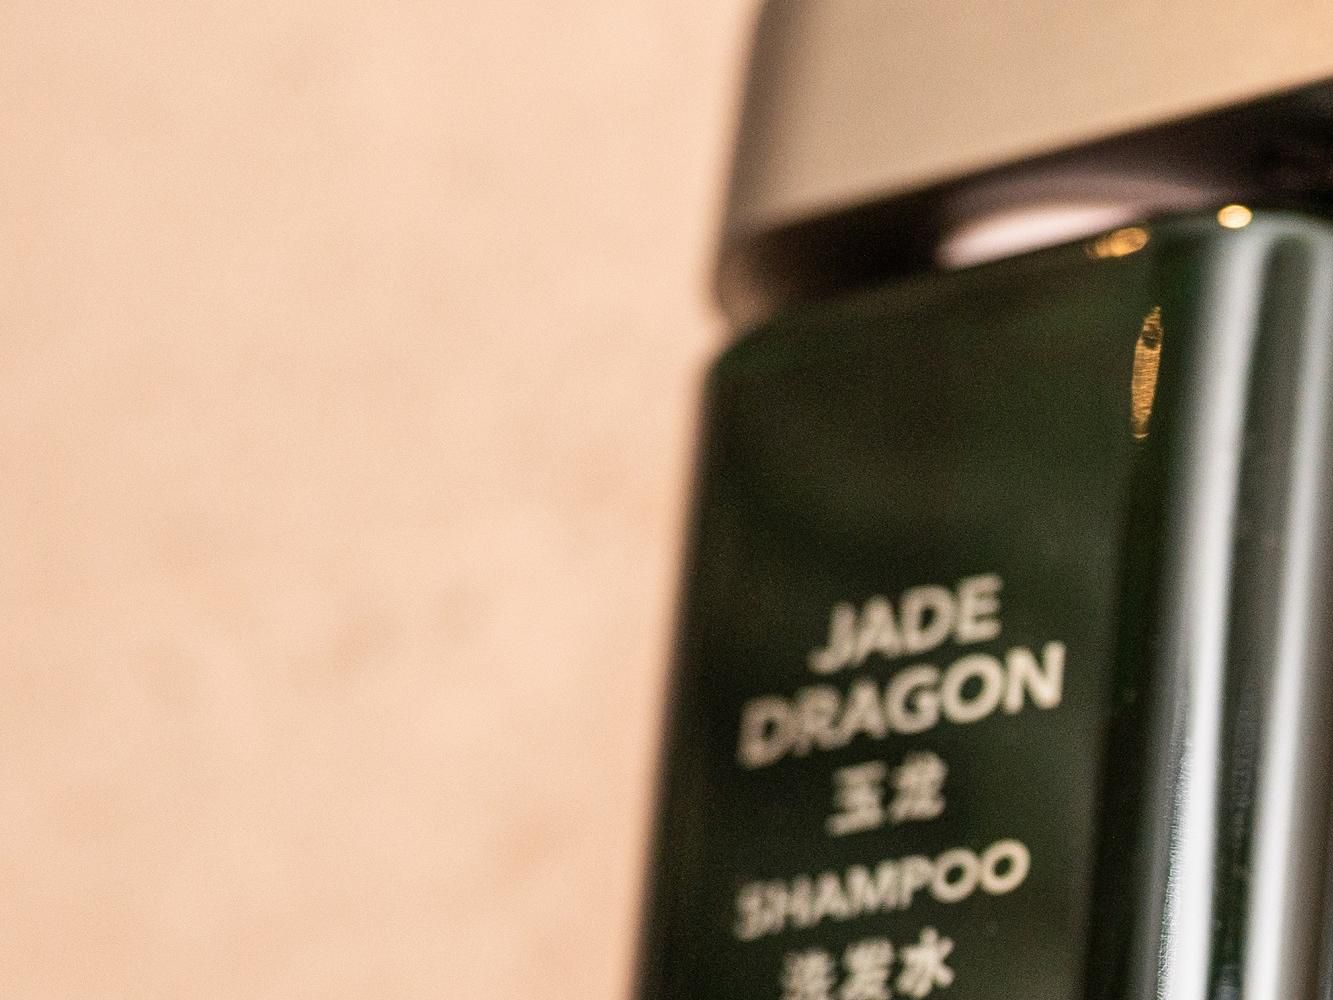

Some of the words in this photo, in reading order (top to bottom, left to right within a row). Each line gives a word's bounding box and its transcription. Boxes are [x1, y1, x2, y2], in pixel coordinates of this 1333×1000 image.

[809, 574, 1002, 674] JADE
[738, 641, 1066, 769] DRAGON
[734, 839, 1031, 941] SHAMPOO
